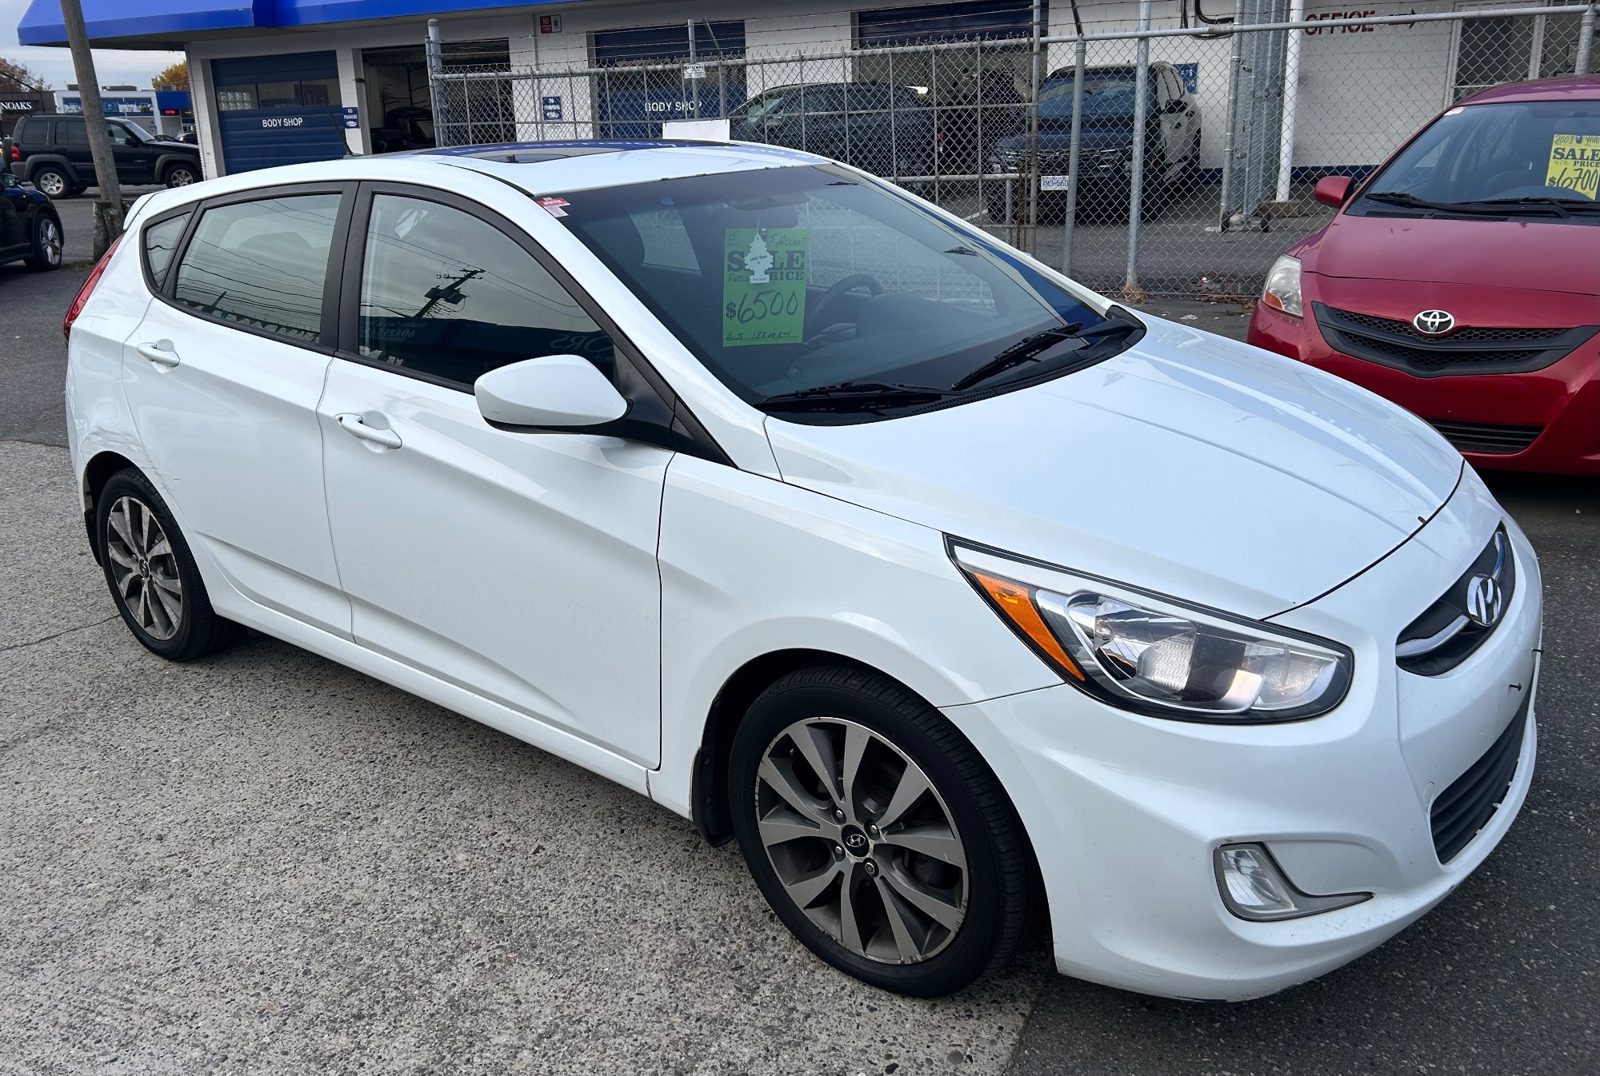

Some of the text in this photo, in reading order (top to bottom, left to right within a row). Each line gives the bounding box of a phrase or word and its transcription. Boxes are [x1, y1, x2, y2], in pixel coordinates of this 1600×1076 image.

[645, 101, 672, 112] BODY
[262, 117, 303, 128] BODY SHOP
[1553, 147, 1600, 160] SALE
[727, 250, 805, 272] SLE
[769, 270, 805, 281] RICE
